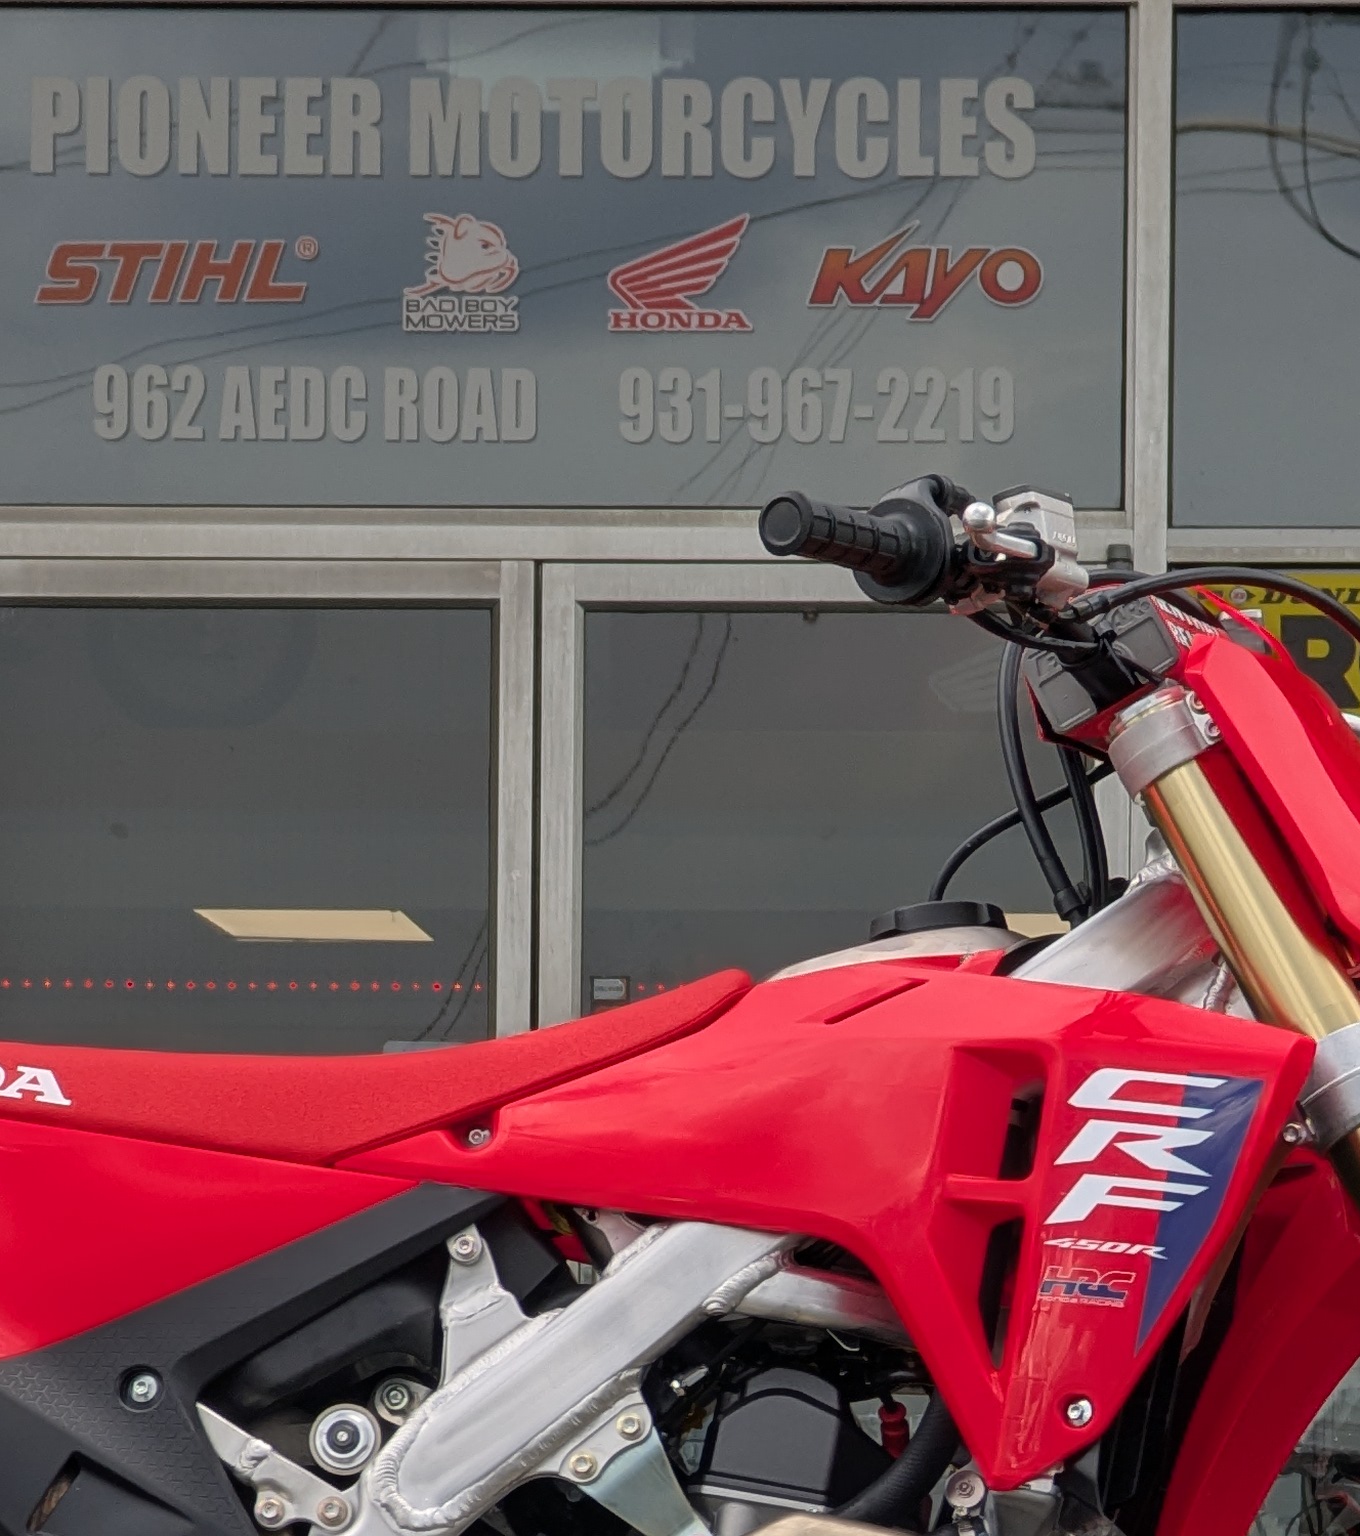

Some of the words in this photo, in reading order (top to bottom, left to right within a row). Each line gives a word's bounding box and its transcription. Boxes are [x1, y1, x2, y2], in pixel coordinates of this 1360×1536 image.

[31, 77, 382, 177] PIONEER
[409, 77, 1036, 179] MOTORCYCLES
[808, 221, 1044, 321] KAYO
[405, 300, 456, 313] BAD
[465, 300, 517, 313] BOY
[405, 314, 516, 329] MOWERS
[610, 311, 751, 330] HONDA
[93, 364, 205, 441] 962
[220, 366, 367, 442] AEDC
[384, 366, 537, 443] ROAD
[619, 366, 1015, 443] 931-967-2219
[1044, 1067, 1228, 1226] CRF
[1043, 1236, 1169, 1260] 450R
[1039, 1265, 1137, 1301] HRC
